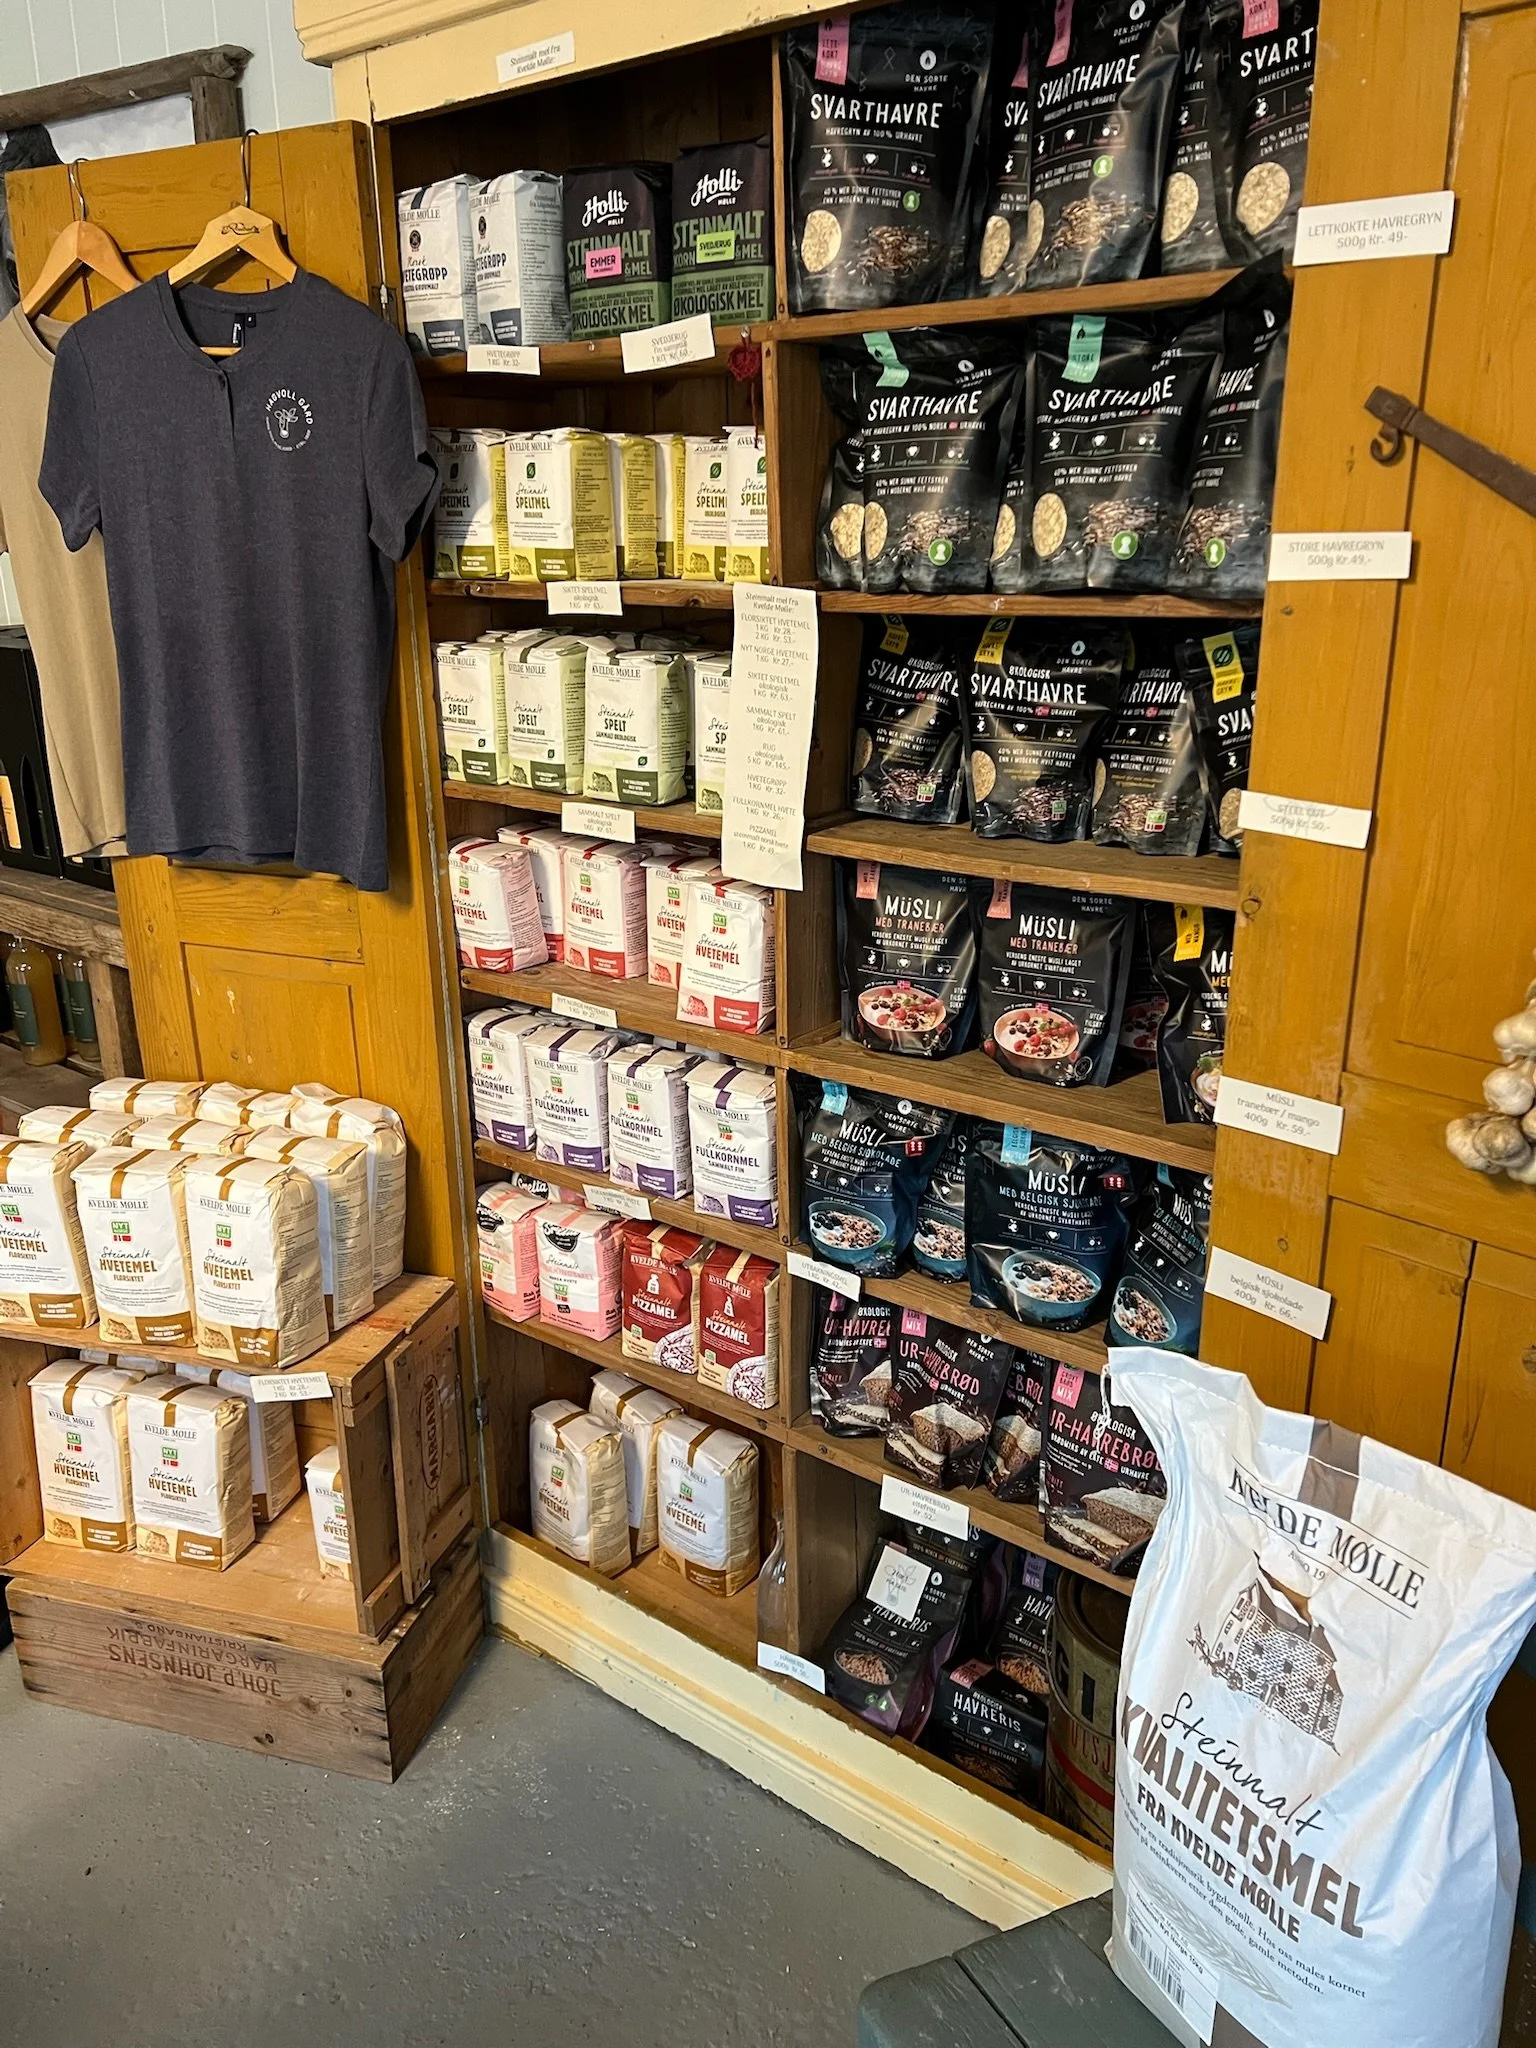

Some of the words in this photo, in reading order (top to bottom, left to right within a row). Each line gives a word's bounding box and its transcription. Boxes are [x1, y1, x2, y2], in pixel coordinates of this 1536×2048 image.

[904, 74, 920, 83] DEN
[924, 74, 948, 83] SORTE
[1037, 54, 1141, 108] SVARTHAVRE
[810, 93, 944, 129] SVARTHAVRE
[691, 168, 744, 207] Holli
[582, 190, 629, 227] Holli
[1308, 219, 1370, 237] LETTKOKTE
[1373, 212, 1443, 229] HAVREGRYN
[700, 238, 732, 251] SVEDJERUG
[590, 254, 616, 267] EMMER
[673, 290, 735, 316] ØKOLOGISK
[737, 287, 764, 309] MEL
[631, 303, 655, 323] MEL
[1048, 374, 1176, 412] SVARTHAVRE
[867, 390, 982, 421] SVARTHAVRE
[516, 497, 550, 509] SPELTMEL
[1288, 542, 1320, 552] STORE
[1323, 540, 1385, 551] HAVREGRYN
[741, 613, 776, 625] FLORSIKTET
[778, 619, 810, 630] HVETEMEL
[754, 646, 775, 656] NORGE
[776, 650, 808, 660] HVETEMEL
[592, 665, 614, 675] KVELDE
[616, 667, 641, 678] MØLLE
[747, 672, 768, 681] SIKTET
[769, 674, 800, 686] SPELTMEL
[971, 673, 1087, 705] SVARTHAVRE
[448, 704, 468, 716] SPELT
[597, 704, 635, 718] Steinmalt
[746, 706, 777, 718] SAMMALT
[778, 711, 796, 720] SPELT
[518, 714, 537, 726] SPELT
[604, 719, 627, 731] SPELT
[762, 742, 776, 751] RUG
[778, 806, 796, 816] HVETE
[749, 824, 777, 837] PIZZAMEL
[571, 901, 604, 920] HVETEMEL
[884, 894, 942, 920] MÜSLI
[875, 917, 893, 928] MED
[897, 918, 945, 934] TRANEBÆR
[1019, 914, 1076, 940] MÜSLI
[698, 933, 738, 950] Steinmalt
[1010, 937, 1028, 949] MED
[1031, 939, 1079, 955] TRANEBÆR
[695, 945, 740, 965] HVETEMEL
[535, 1098, 589, 1116] FULLKORNMEL
[1266, 1092, 1295, 1107] MÜSLI
[724, 1111, 750, 1121] MØLLE
[611, 1114, 663, 1138] FULLKORNMEL
[839, 1119, 886, 1147] MÜSLI
[811, 1132, 828, 1145] MED
[695, 1145, 760, 1168] FULLKORNMEL
[1028, 1169, 1085, 1196] MÜSLI
[2, 1205, 18, 1214] NYT
[88, 1199, 118, 1209] KVELDE
[120, 1200, 149, 1209] MØLLE
[200, 1199, 223, 1211] KVELDE
[226, 1204, 251, 1215] MØLLE
[9, 1251, 37, 1260] FLORSIKTET
[100, 1247, 152, 1259] Steinmalt
[204, 1248, 248, 1267] Steinmalt
[100, 1259, 157, 1272] HVETEMEL
[203, 1261, 254, 1281] HVETEMEL
[1230, 1274, 1260, 1293] belgisk
[1262, 1289, 1304, 1311] sjokolade
[632, 1296, 677, 1320] PIZZAMEL
[705, 1317, 750, 1345] PIZZAMEL
[905, 1321, 921, 1331] MIX
[1056, 1386, 1073, 1401] MIX
[145, 1424, 170, 1437] KVELDE
[172, 1430, 197, 1439] MØLLE
[55, 1452, 96, 1469] Steinmalt
[54, 1463, 100, 1482] HVETEMEL
[150, 1467, 193, 1484] Steinmalt
[149, 1478, 197, 1497] HVETEMEL
[666, 1505, 707, 1533] HVETEMEL
[1328, 1526, 1426, 1609] MØLLE
[1025, 1574, 1041, 1588] RIS
[954, 1692, 1021, 1732] HAVRERIS
[1161, 1692, 1323, 1837] Steinmalt
[1120, 1696, 1364, 1939] KVALITETSMEL
[1137, 1783, 1166, 1824] FRA
[1171, 1810, 1236, 1888] KVELDE
[1241, 1874, 1300, 1943] MØLLE
[1206, 1882, 1256, 1932] bygdemølle.
[1259, 1927, 1277, 1951] Hos
[1278, 1947, 1293, 1963] oss
[1296, 1956, 1325, 1982] males
[1329, 1976, 1366, 1999] kornet
[1209, 1899, 1224, 1916] den
[1225, 1913, 1247, 1940] gode,
[1248, 1935, 1275, 1963] gamle
[1278, 1956, 1324, 1995] metoden.
